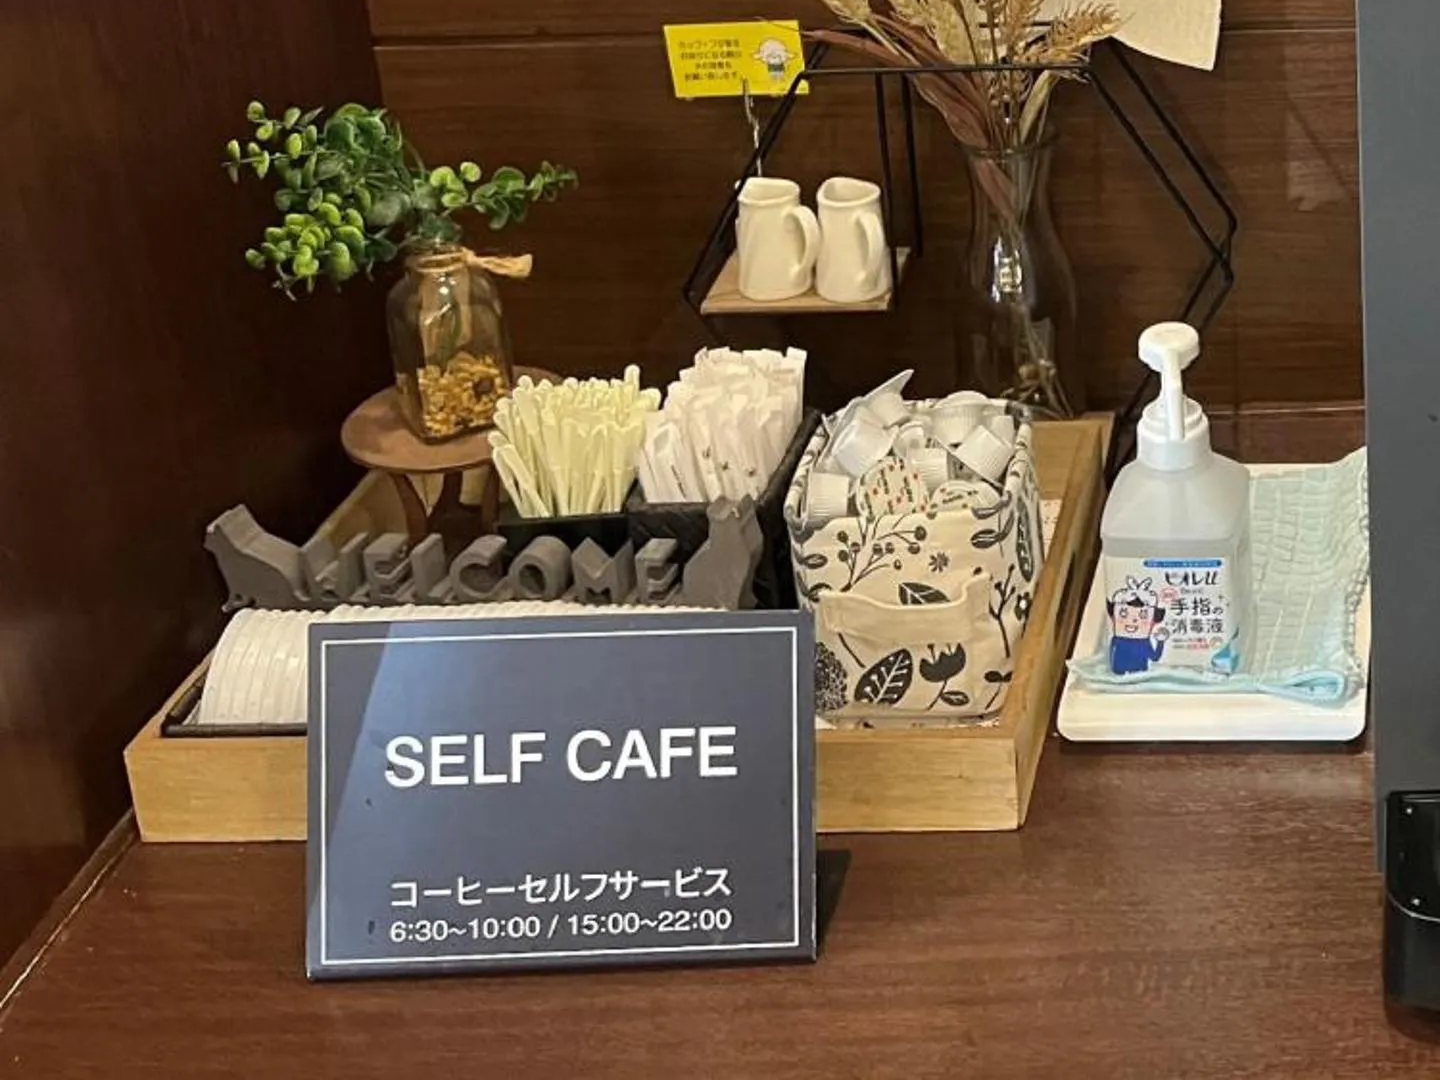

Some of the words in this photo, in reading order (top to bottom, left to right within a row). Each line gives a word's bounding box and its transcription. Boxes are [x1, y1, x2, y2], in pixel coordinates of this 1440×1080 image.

[1170, 597, 1224, 617] 手指の
[385, 731, 547, 788] SELF
[566, 726, 737, 782] CAFE
[390, 867, 732, 909] コーヒーセルフサービス
[390, 916, 541, 943] 6:30~10:00
[568, 909, 733, 936] 15:00~22:00
